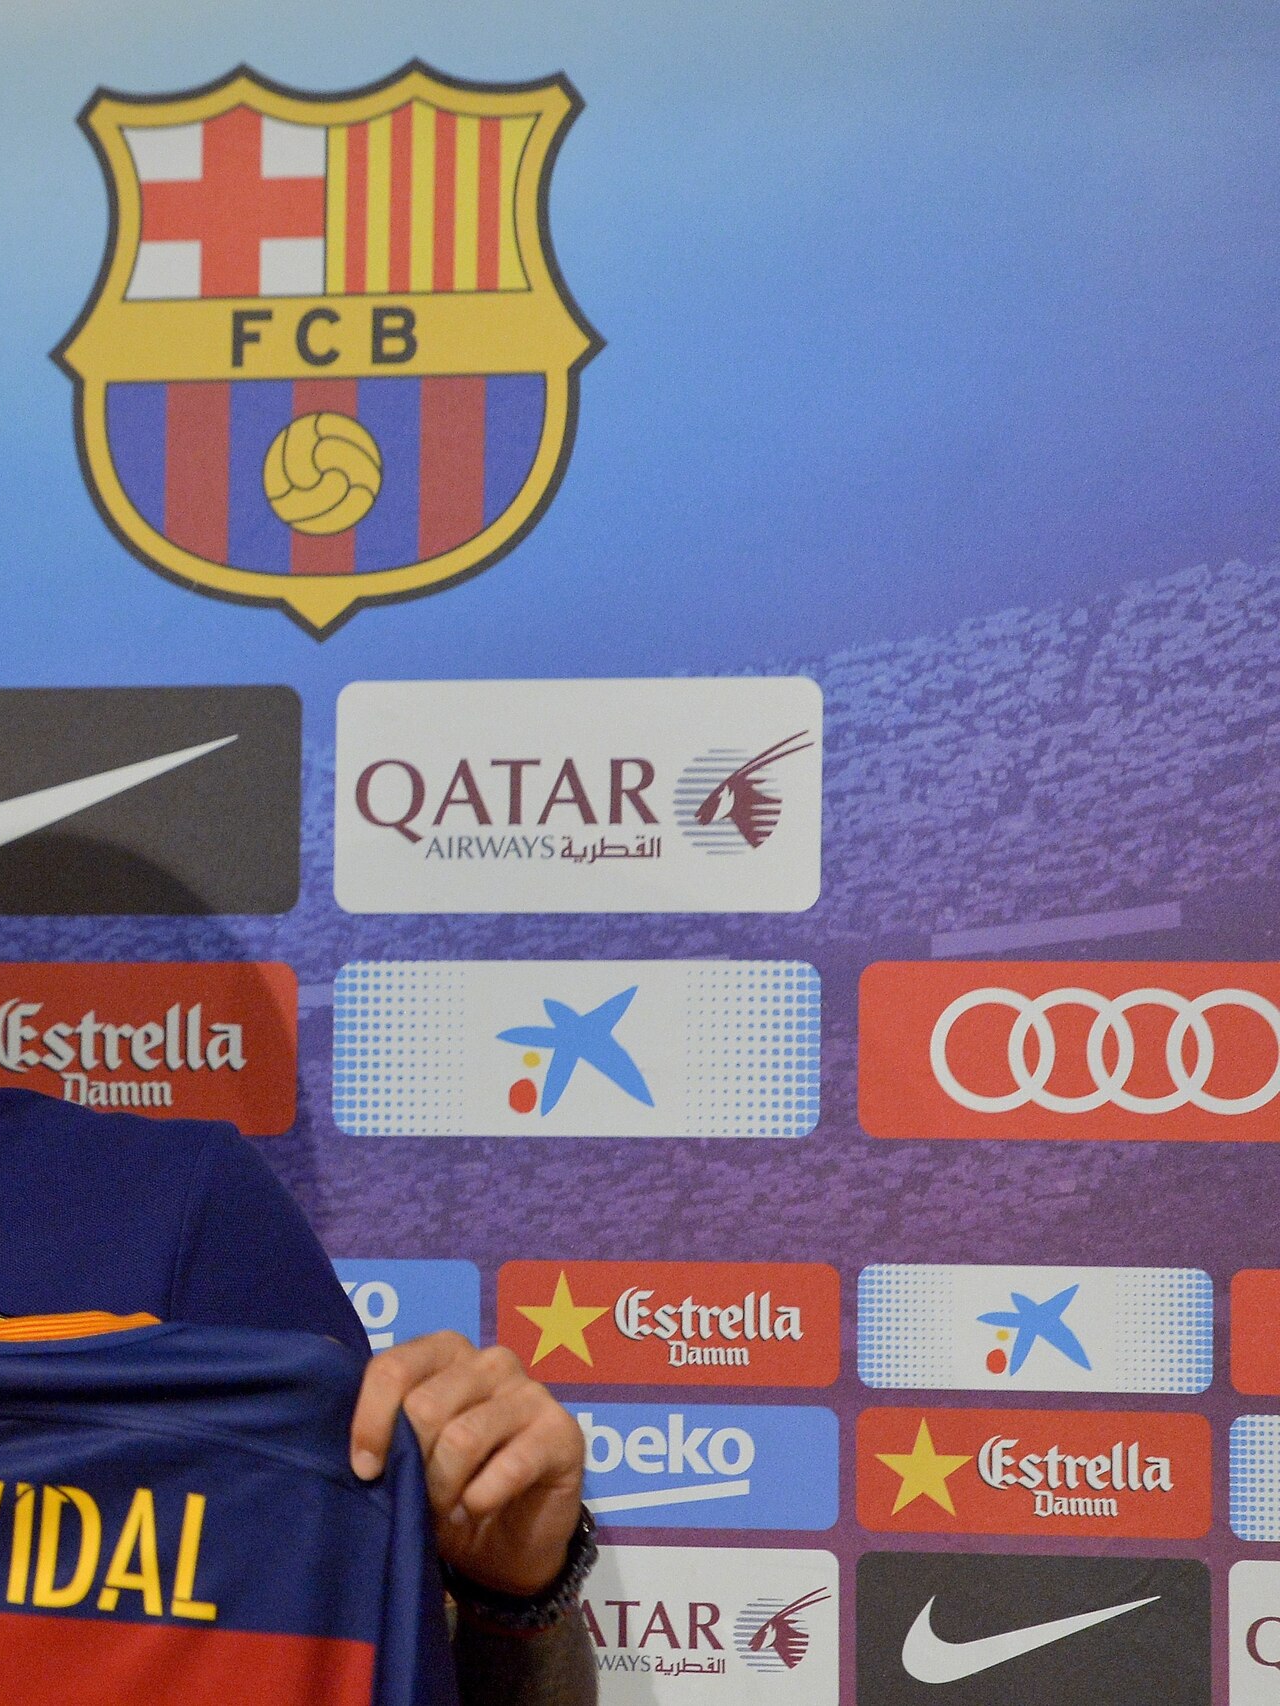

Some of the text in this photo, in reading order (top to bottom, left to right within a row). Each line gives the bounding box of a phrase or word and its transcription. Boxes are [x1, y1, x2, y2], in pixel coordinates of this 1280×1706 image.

[354, 757, 661, 844] QATAR
[425, 834, 555, 860] AIRWAYS
[559, 834, 662, 864] القطرية
[60, 1071, 174, 1107] Damm
[613, 1285, 804, 1342] Estrella
[667, 1339, 750, 1368] Damm
[577, 1412, 756, 1476] beko
[977, 1434, 1174, 1492] Estrella
[1032, 1490, 1119, 1518] Damm
[581, 1599, 724, 1650] ATAR
[596, 1654, 651, 1672] WAYS
[655, 1655, 725, 1676] القطرية
